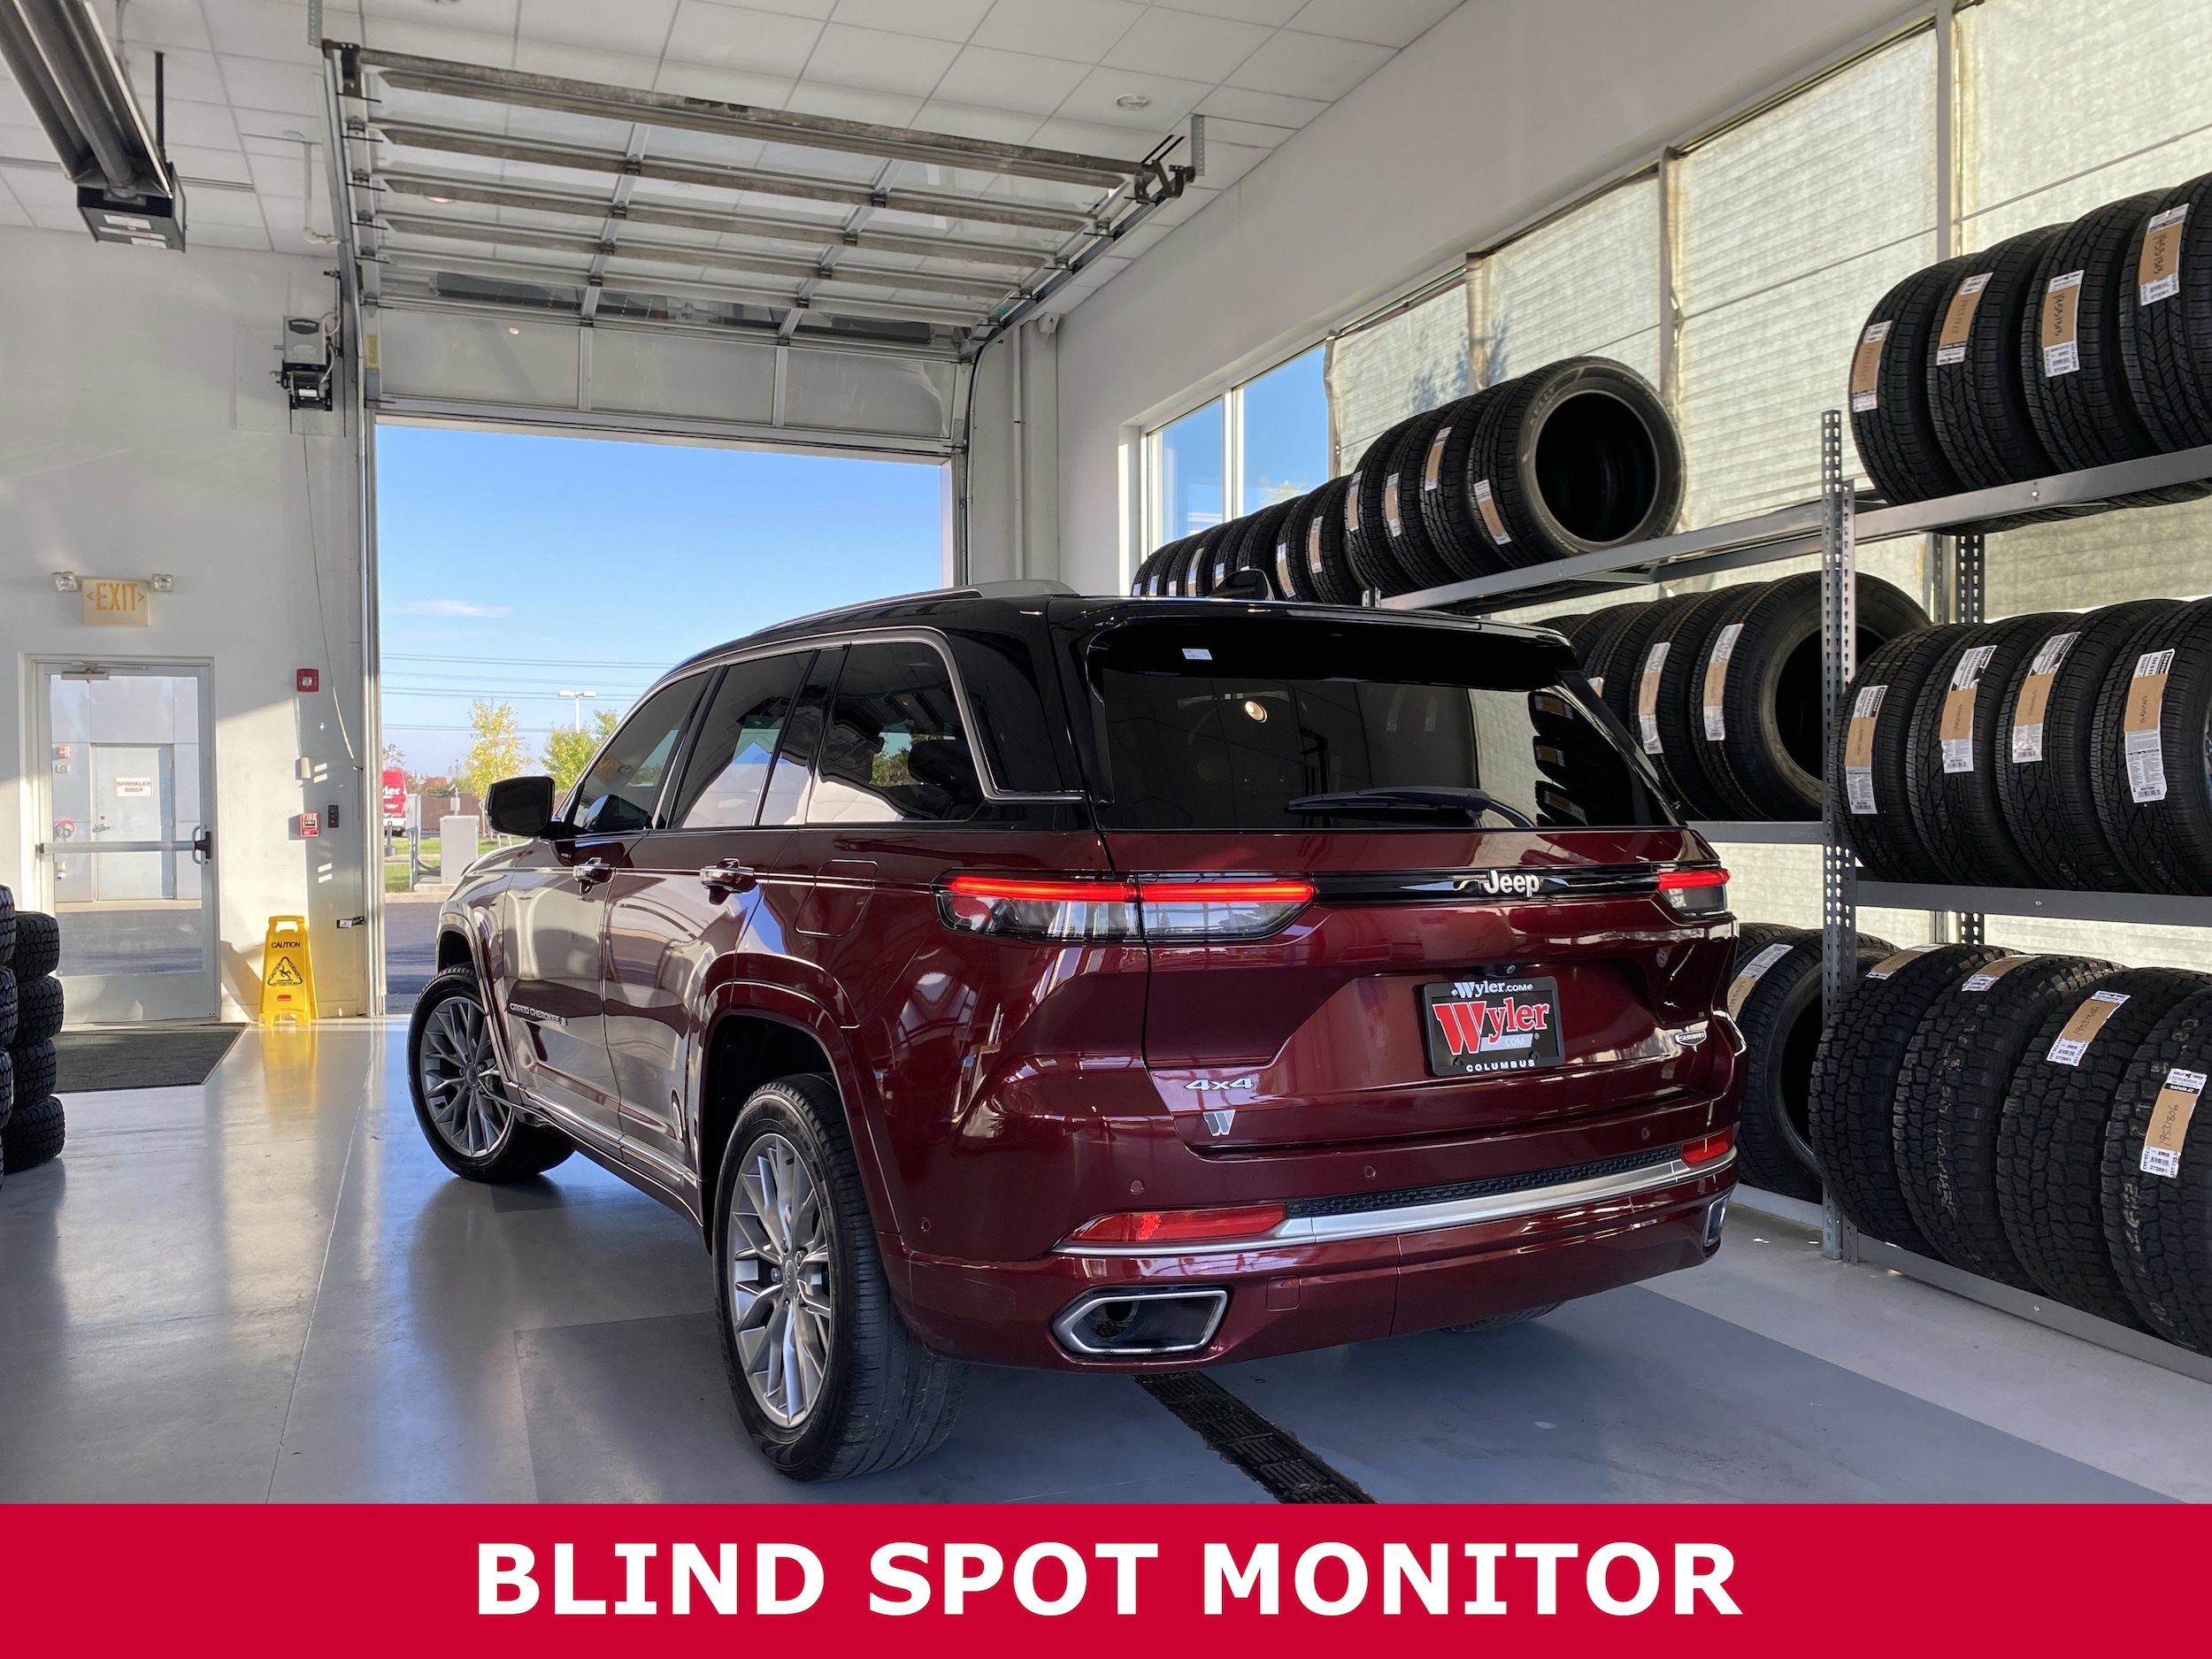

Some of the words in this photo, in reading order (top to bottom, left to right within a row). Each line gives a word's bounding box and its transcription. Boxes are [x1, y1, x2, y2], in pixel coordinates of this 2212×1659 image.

[96, 582, 137, 611] EXIT
[1482, 869, 1540, 898] Jeep
[510, 1002, 529, 1014] GRAND
[530, 1008, 560, 1024] CHEROKEE
[1432, 996, 1550, 1056] Wyler
[1679, 1033, 1706, 1041] SUMMIT
[1466, 1059, 1535, 1072] COLUMBUS
[1185, 1078, 1254, 1091] 4x4
[2159, 1104, 2179, 1147] 19531806
